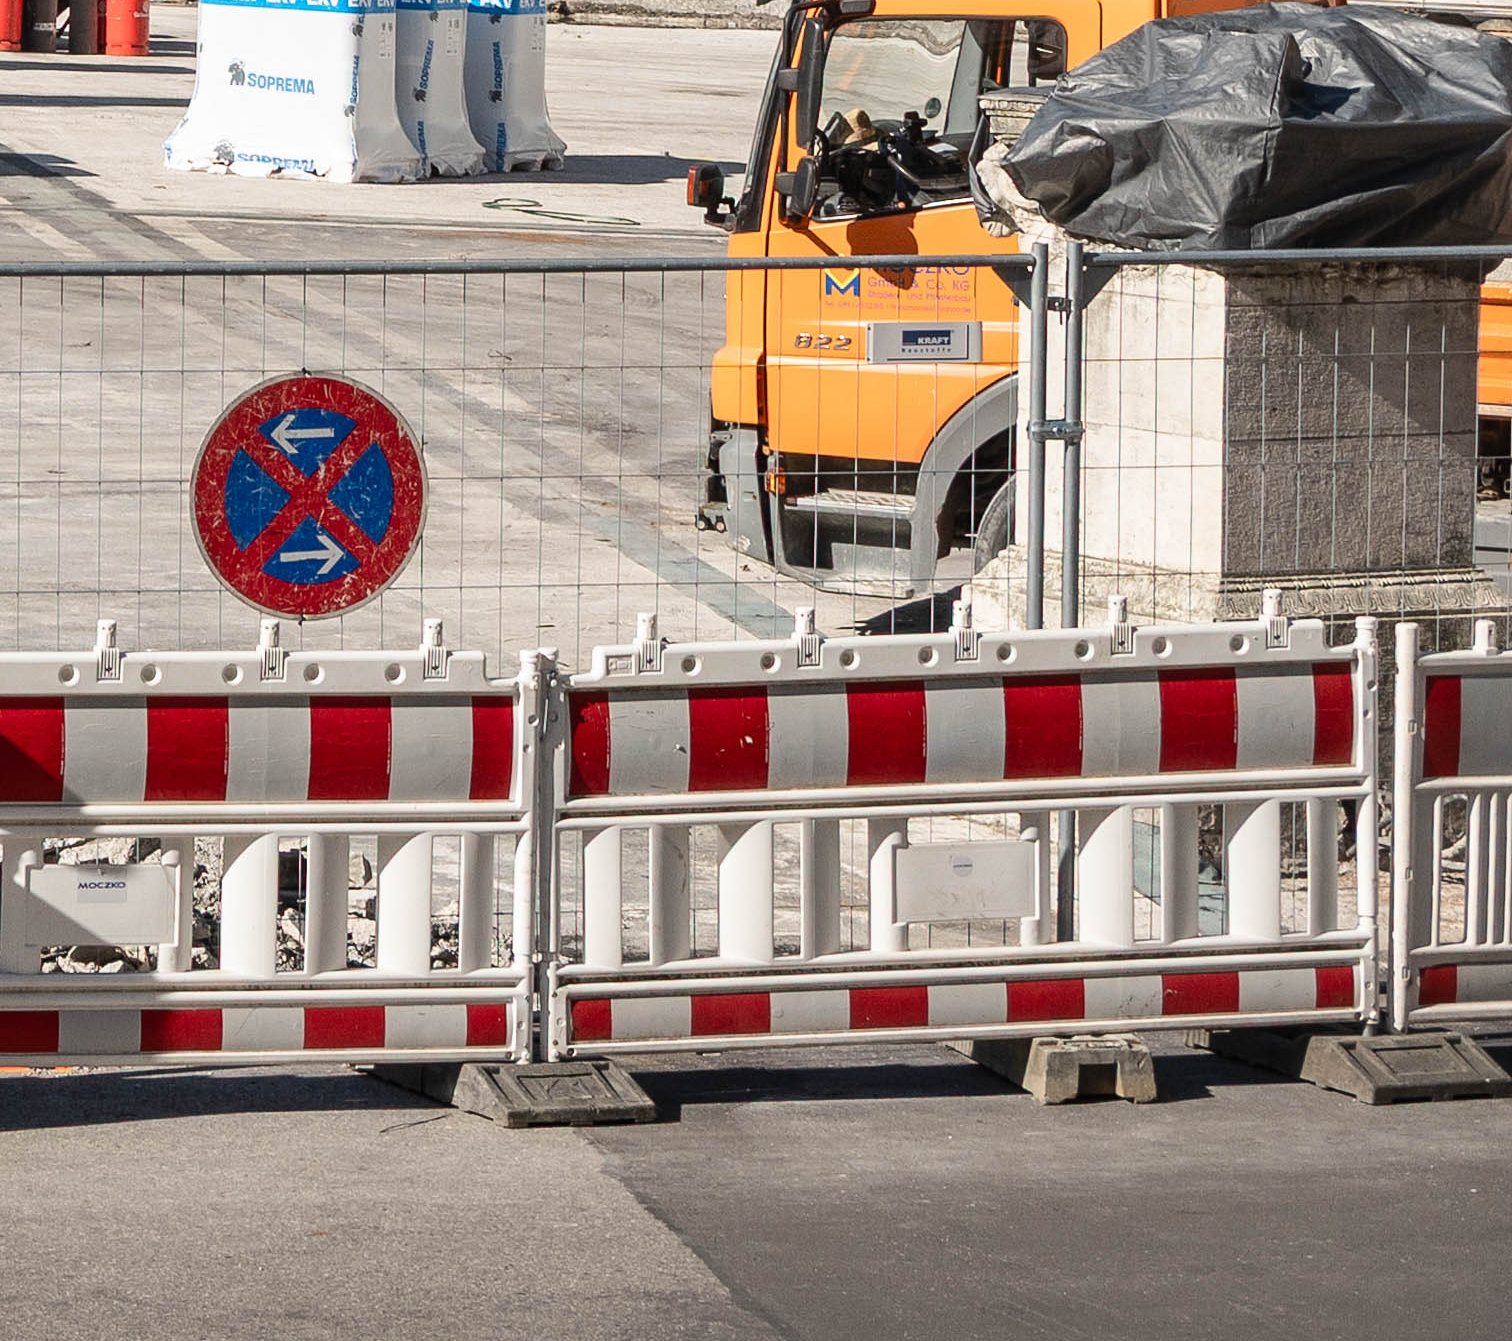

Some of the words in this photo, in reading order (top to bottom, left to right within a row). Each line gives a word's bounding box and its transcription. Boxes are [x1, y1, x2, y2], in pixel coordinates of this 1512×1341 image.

[247, 72, 316, 95] SOPREMA
[952, 280, 971, 291] KG
[795, 333, 852, 351] 822
[917, 337, 950, 345] KRAFT
[78, 881, 127, 889] MOCZKO
